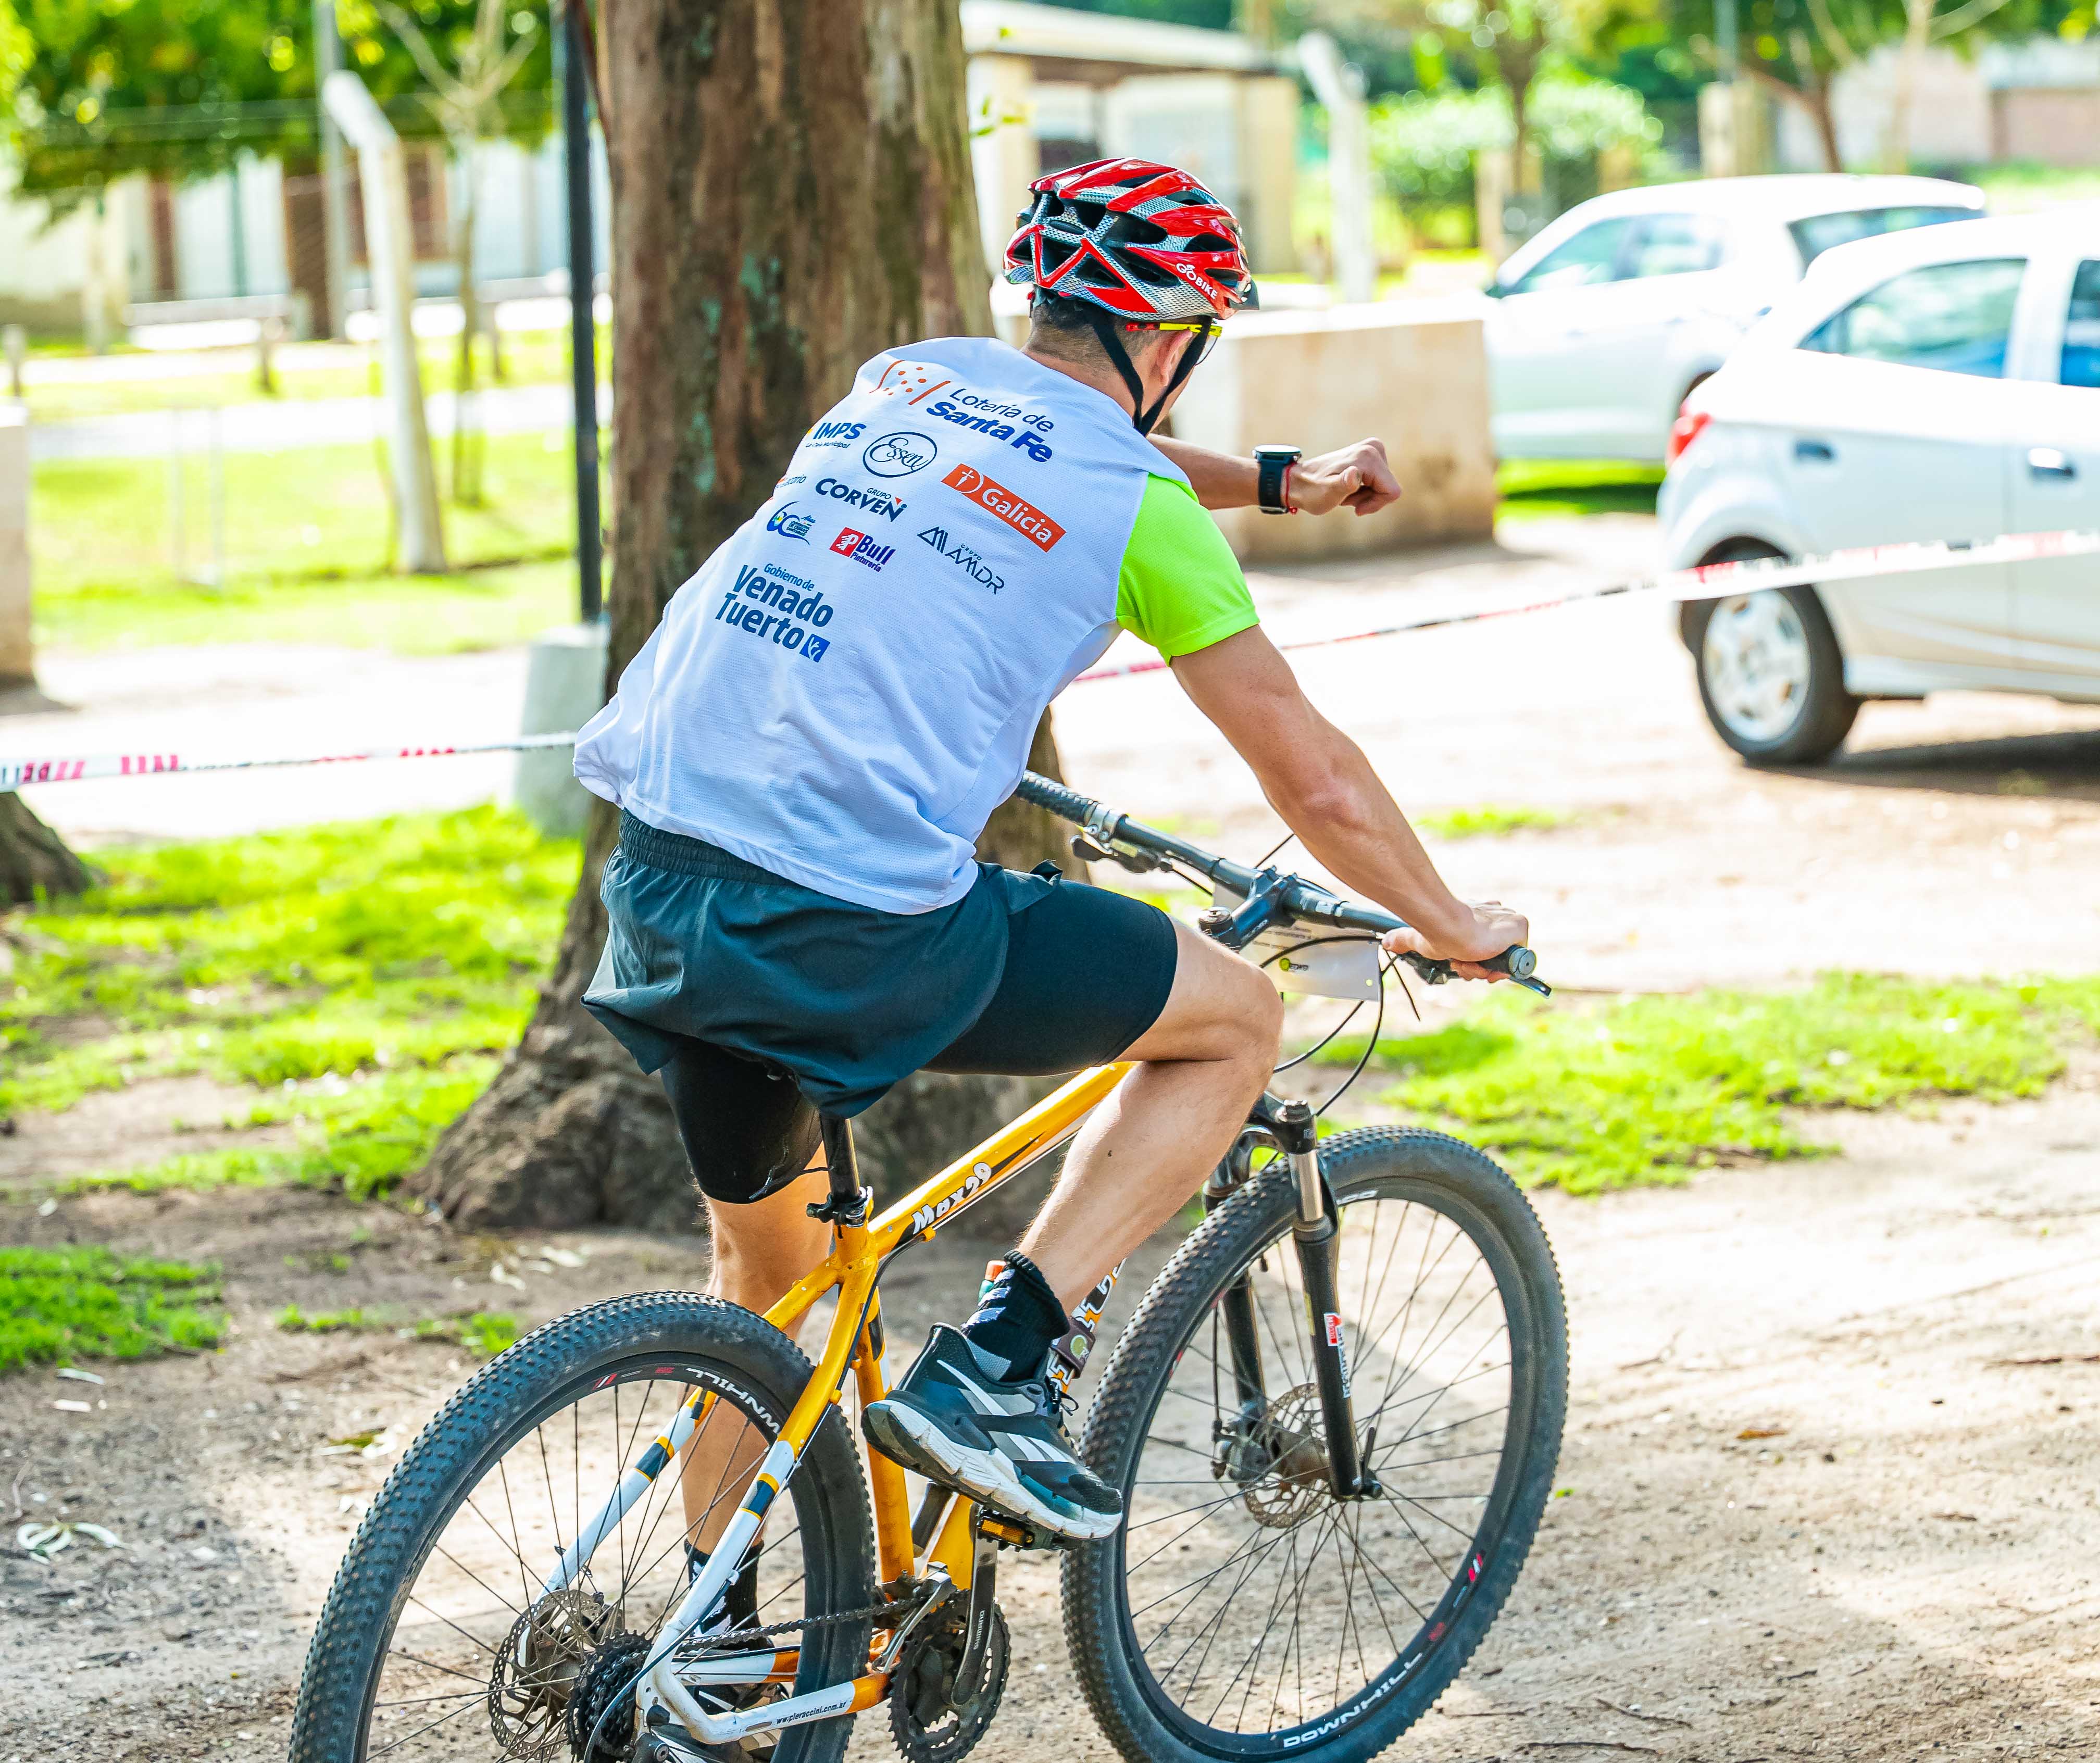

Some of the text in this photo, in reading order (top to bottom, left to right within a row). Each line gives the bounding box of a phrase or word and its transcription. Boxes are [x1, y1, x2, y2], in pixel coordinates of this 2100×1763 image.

[813, 422, 867, 440] IMPS
[926, 402, 1053, 462] Santa Fe
[949, 388, 1054, 432] Lotería de
[870, 437, 929, 471] Essen
[815, 478, 904, 522] CORVEN
[867, 487, 892, 499] GRUPO
[982, 488, 1052, 543] Galicia
[855, 534, 896, 565] Bull
[960, 544, 982, 561] GRUPO
[733, 565, 834, 628] Venado
[764, 563, 815, 592] Gobierno de
[715, 592, 805, 649] Tuerto
[686, 1367, 781, 1434] WNHILL
[1283, 1652, 1423, 1748] DOWNHILL
